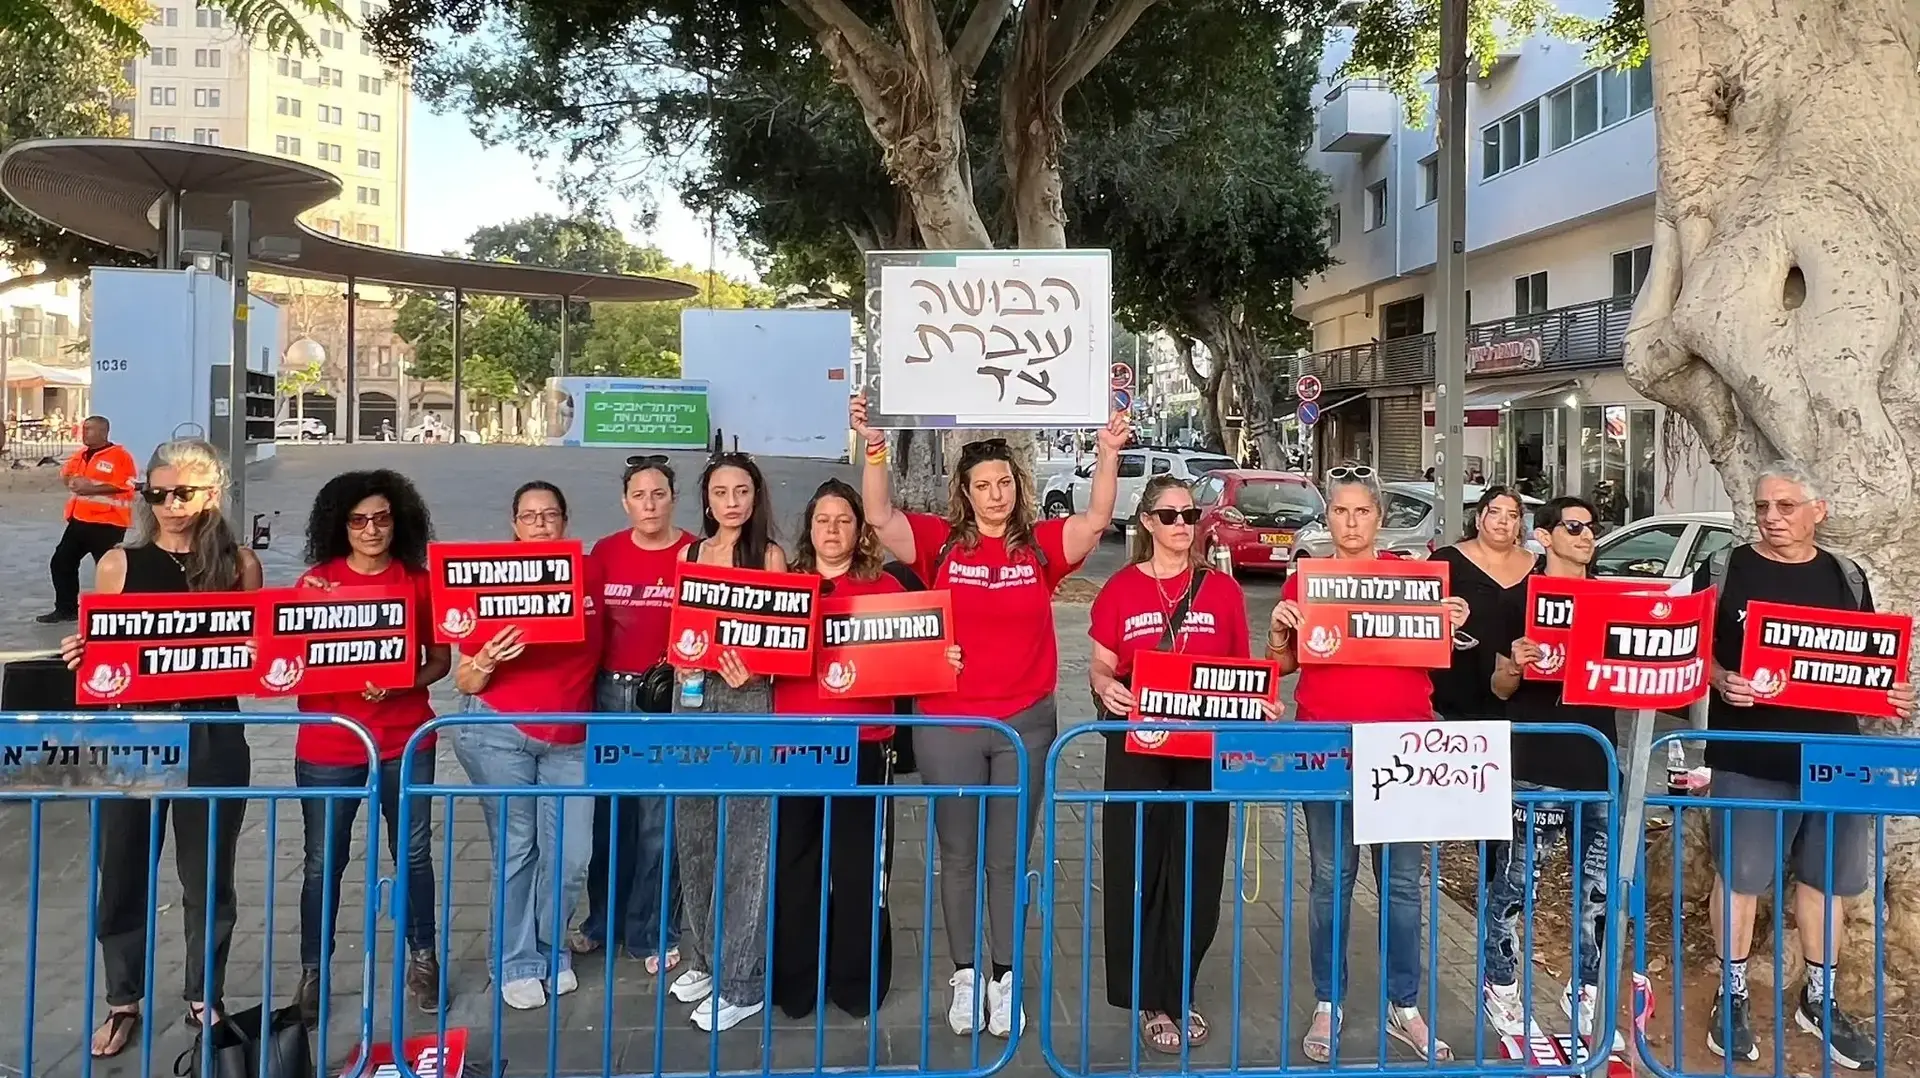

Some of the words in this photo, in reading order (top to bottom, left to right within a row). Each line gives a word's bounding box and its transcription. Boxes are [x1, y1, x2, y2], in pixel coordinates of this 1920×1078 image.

[905, 323, 1073, 366] עוברת
[96, 359, 128, 372] 1036
[976, 365, 1058, 406] צד
[613, 413, 631, 422] את
[632, 413, 677, 423] מחדשת
[447, 560, 543, 585] שמאמינה
[546, 559, 570, 582] מי
[681, 580, 731, 606] להיות
[731, 586, 772, 610] יכלה
[1307, 576, 1359, 599] להיות
[1360, 577, 1401, 599] יכלה
[1404, 579, 1441, 601] זאת
[479, 595, 545, 616] מפחדת
[547, 592, 572, 614] לא
[773, 591, 811, 613] זאת
[91, 611, 155, 636] להיות
[158, 610, 206, 634] יכלה
[209, 610, 251, 632] זאת
[278, 604, 378, 632] שמאמינה
[381, 603, 404, 626] מי
[1184, 611, 1215, 626] מאב
[1351, 612, 1395, 638] שלך
[719, 619, 762, 646] שלך
[763, 625, 807, 649] הבת
[825, 617, 861, 644] לכן!
[863, 614, 940, 641] מאמינות
[1398, 615, 1440, 639] הבת
[1764, 622, 1868, 652] שמאמינה
[380, 636, 404, 660] לא
[1609, 625, 1699, 657] שמור
[1872, 632, 1896, 656] מי
[144, 647, 196, 674] שלך
[201, 645, 249, 670] הבת
[309, 641, 376, 666] מפחדת
[1193, 666, 1267, 693] דורשות
[1792, 659, 1862, 685] מפחדת
[1865, 665, 1893, 688] לא
[1139, 687, 1202, 717] אחרת!
[1204, 695, 1263, 720] תרבות
[89, 745, 181, 765] עיריית
[772, 745, 851, 765] עיריית
[1513, 808, 1547, 825] ALYS
[1547, 812, 1564, 825] RUN
